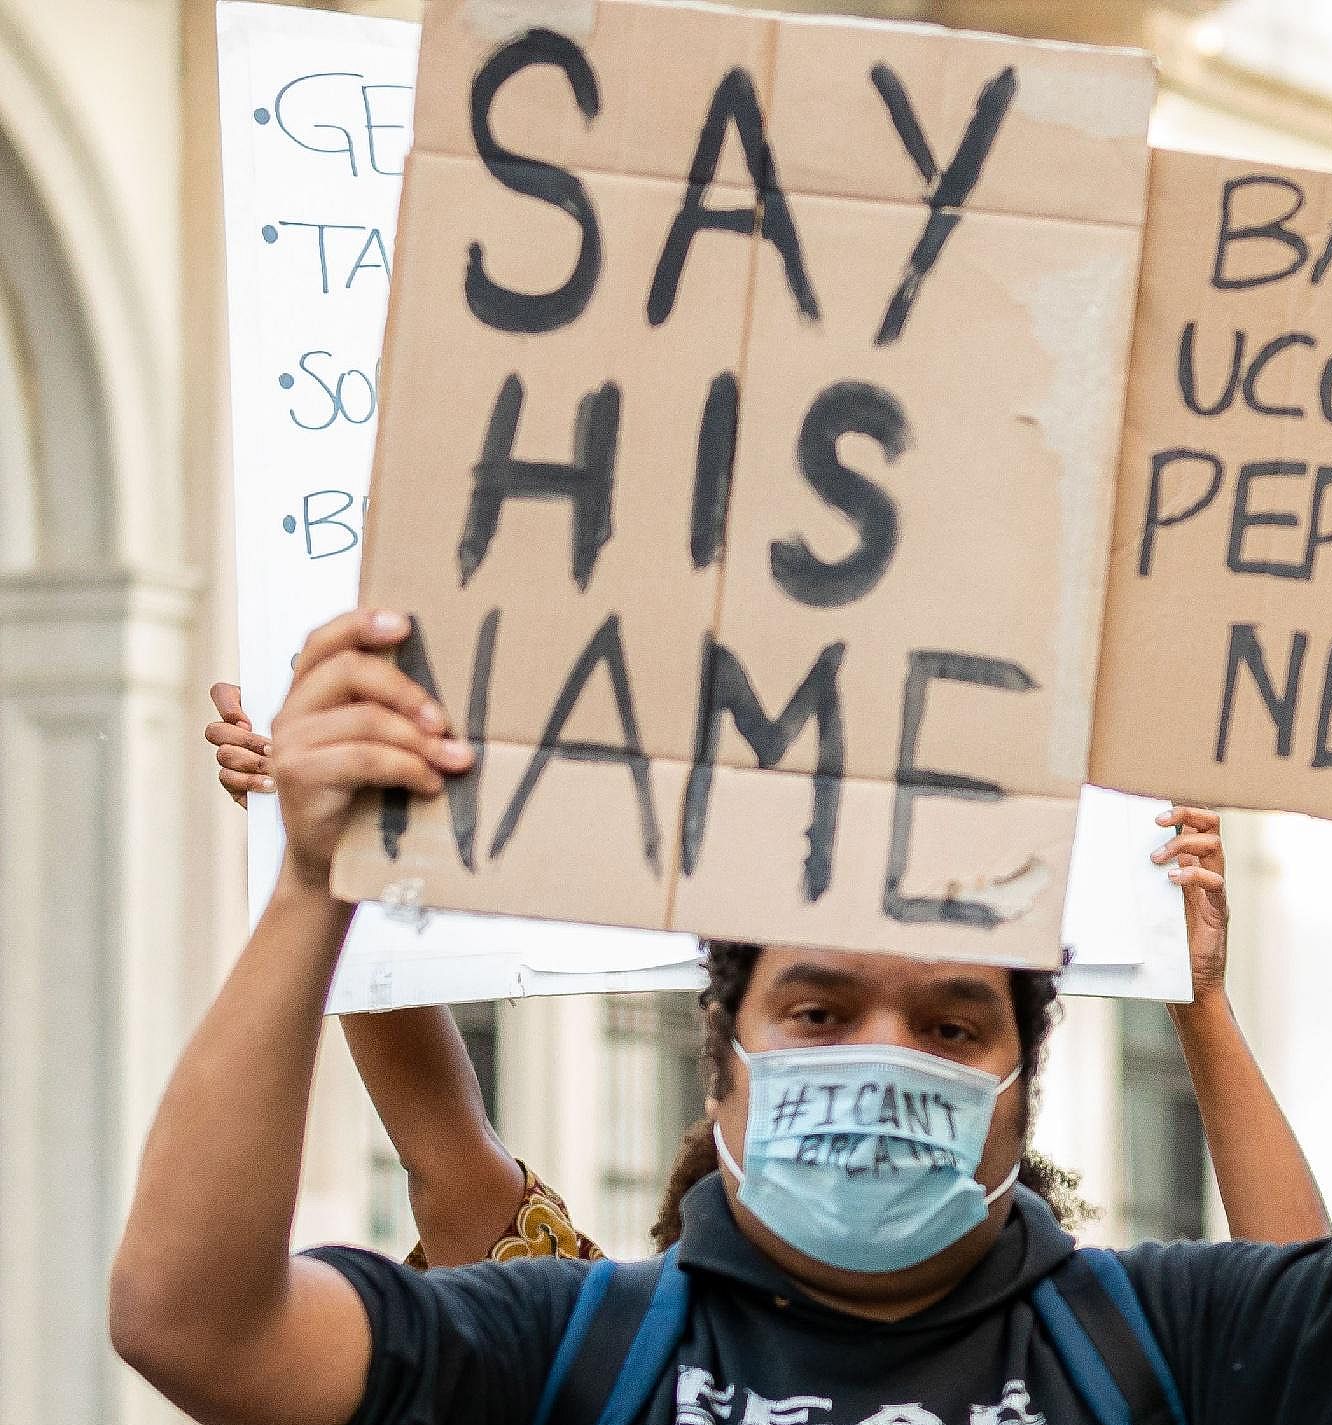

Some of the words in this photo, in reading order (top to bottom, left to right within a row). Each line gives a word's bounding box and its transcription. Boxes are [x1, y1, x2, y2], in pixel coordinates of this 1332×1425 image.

[275, 72, 414, 177] GE
[464, 28, 1016, 345] SAY
[290, 350, 380, 429] SO
[303, 490, 369, 559] B
[458, 371, 914, 608] HIS
[378, 608, 1041, 928] NAME
